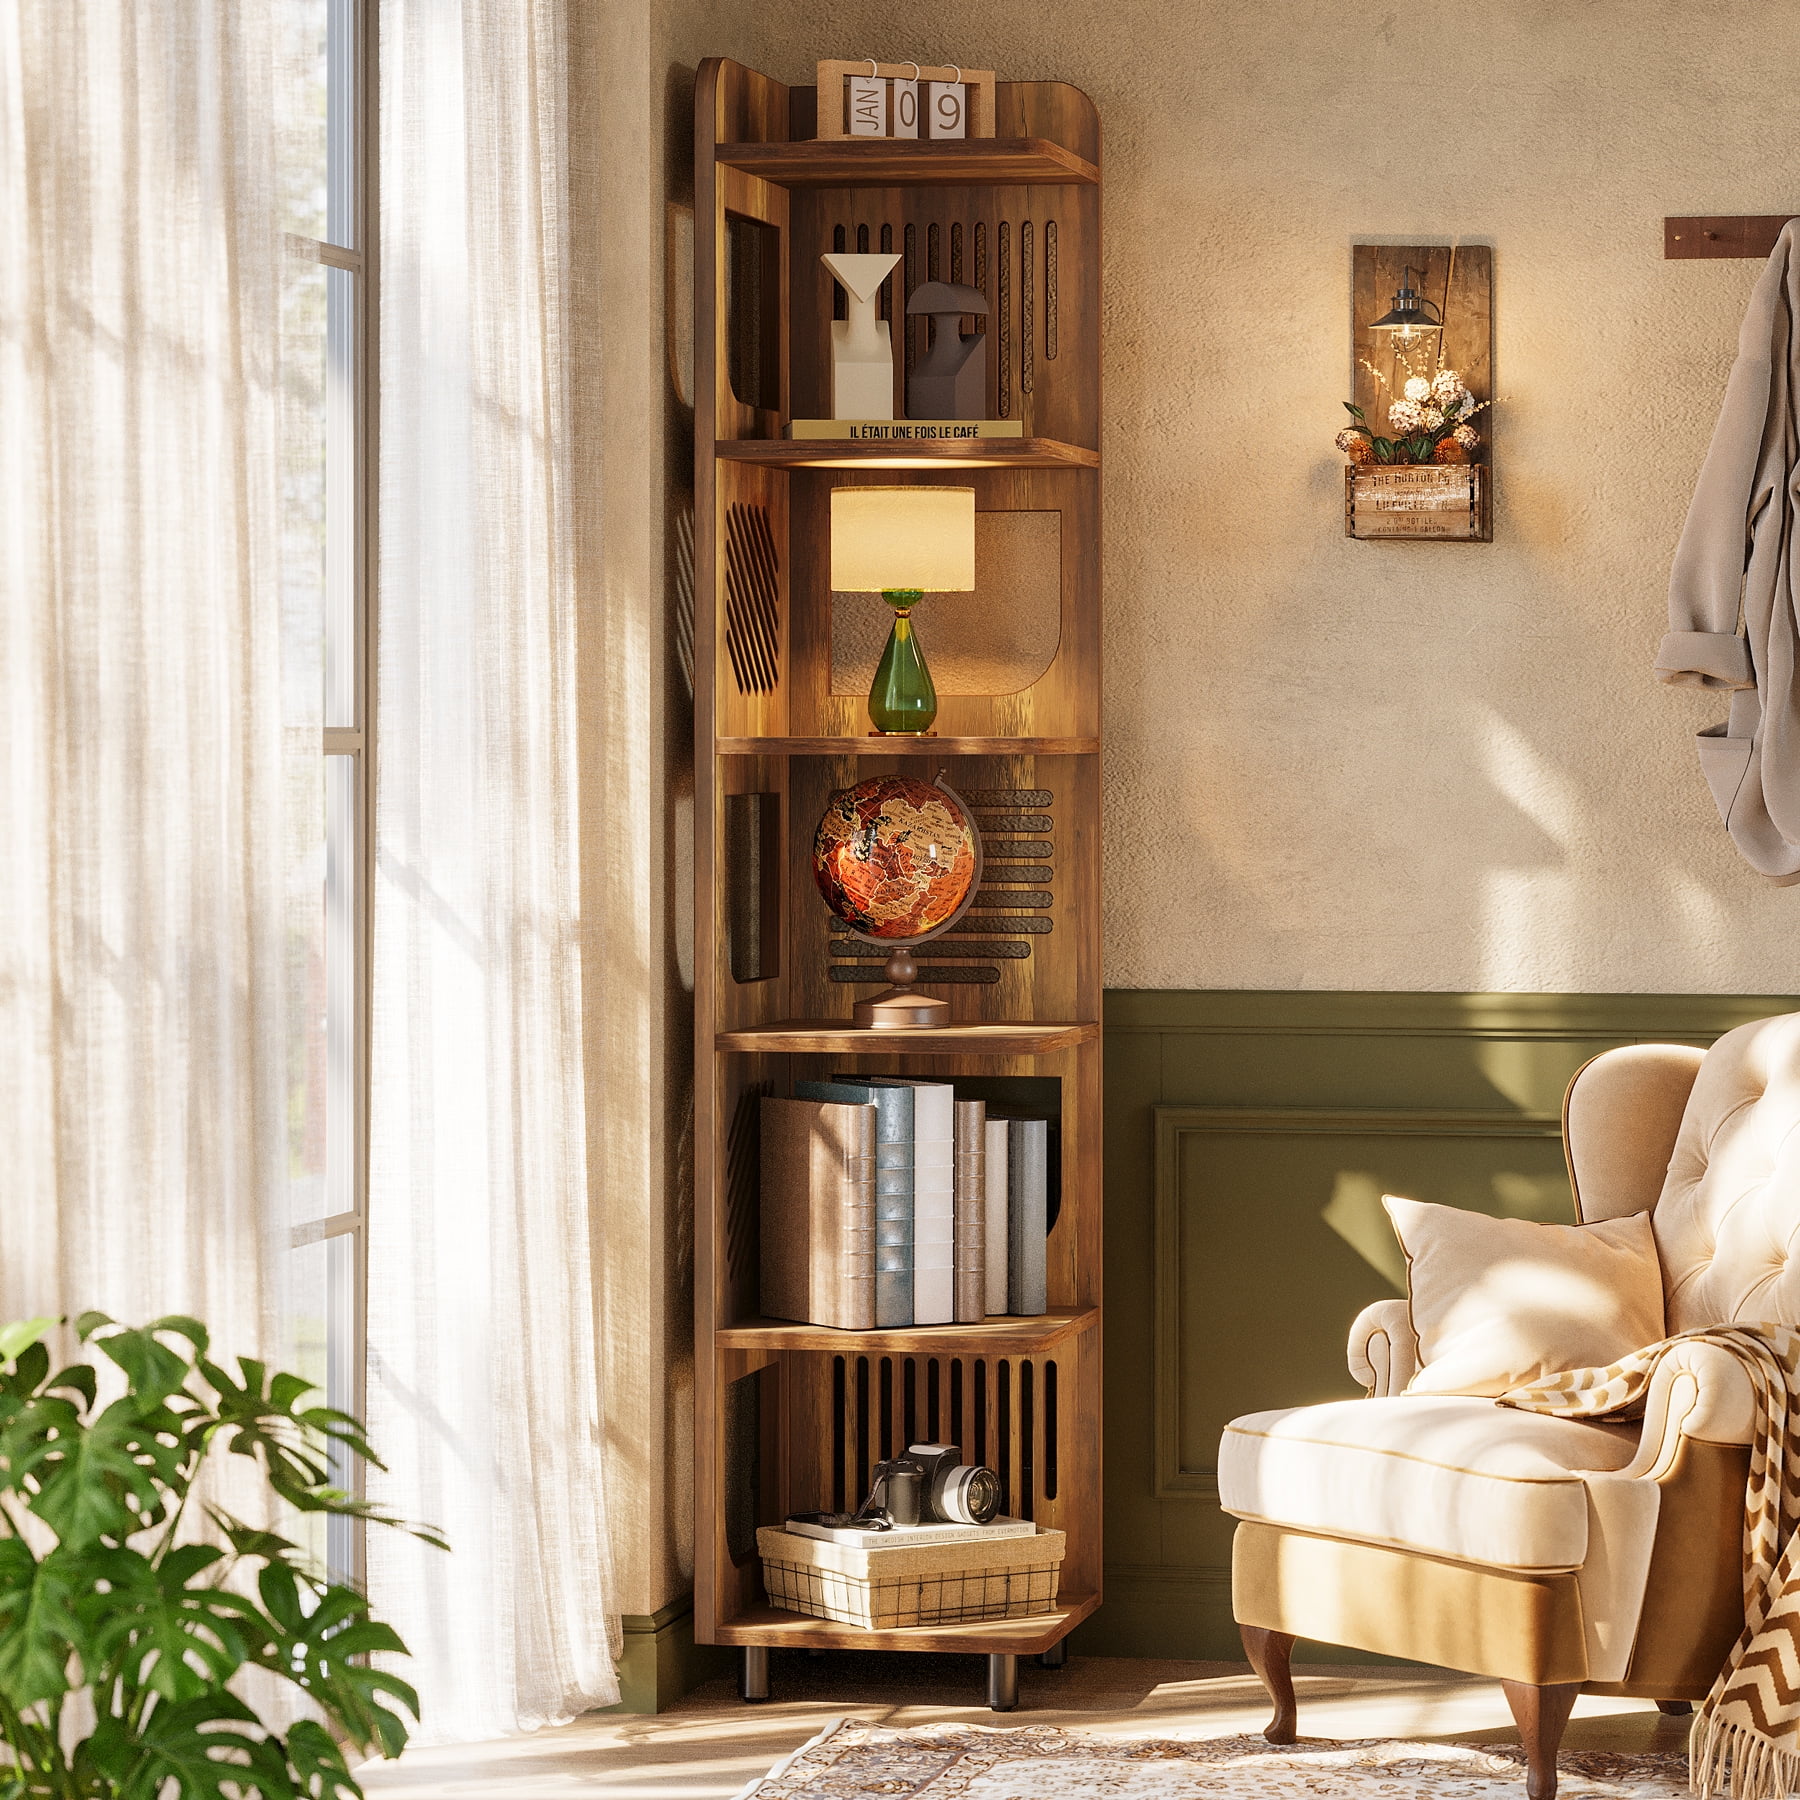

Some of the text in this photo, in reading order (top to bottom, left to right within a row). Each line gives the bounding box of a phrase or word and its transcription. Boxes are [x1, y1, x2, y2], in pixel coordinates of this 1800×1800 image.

[855, 89, 879, 131] JAN
[850, 424, 979, 438] IL ÉTAIT UNE FOIS LE CAFÉ
[1372, 476, 1391, 487] THE
[935, 1532, 954, 1540] DESIGN
[997, 1526, 1029, 1535] EVERMOTION
